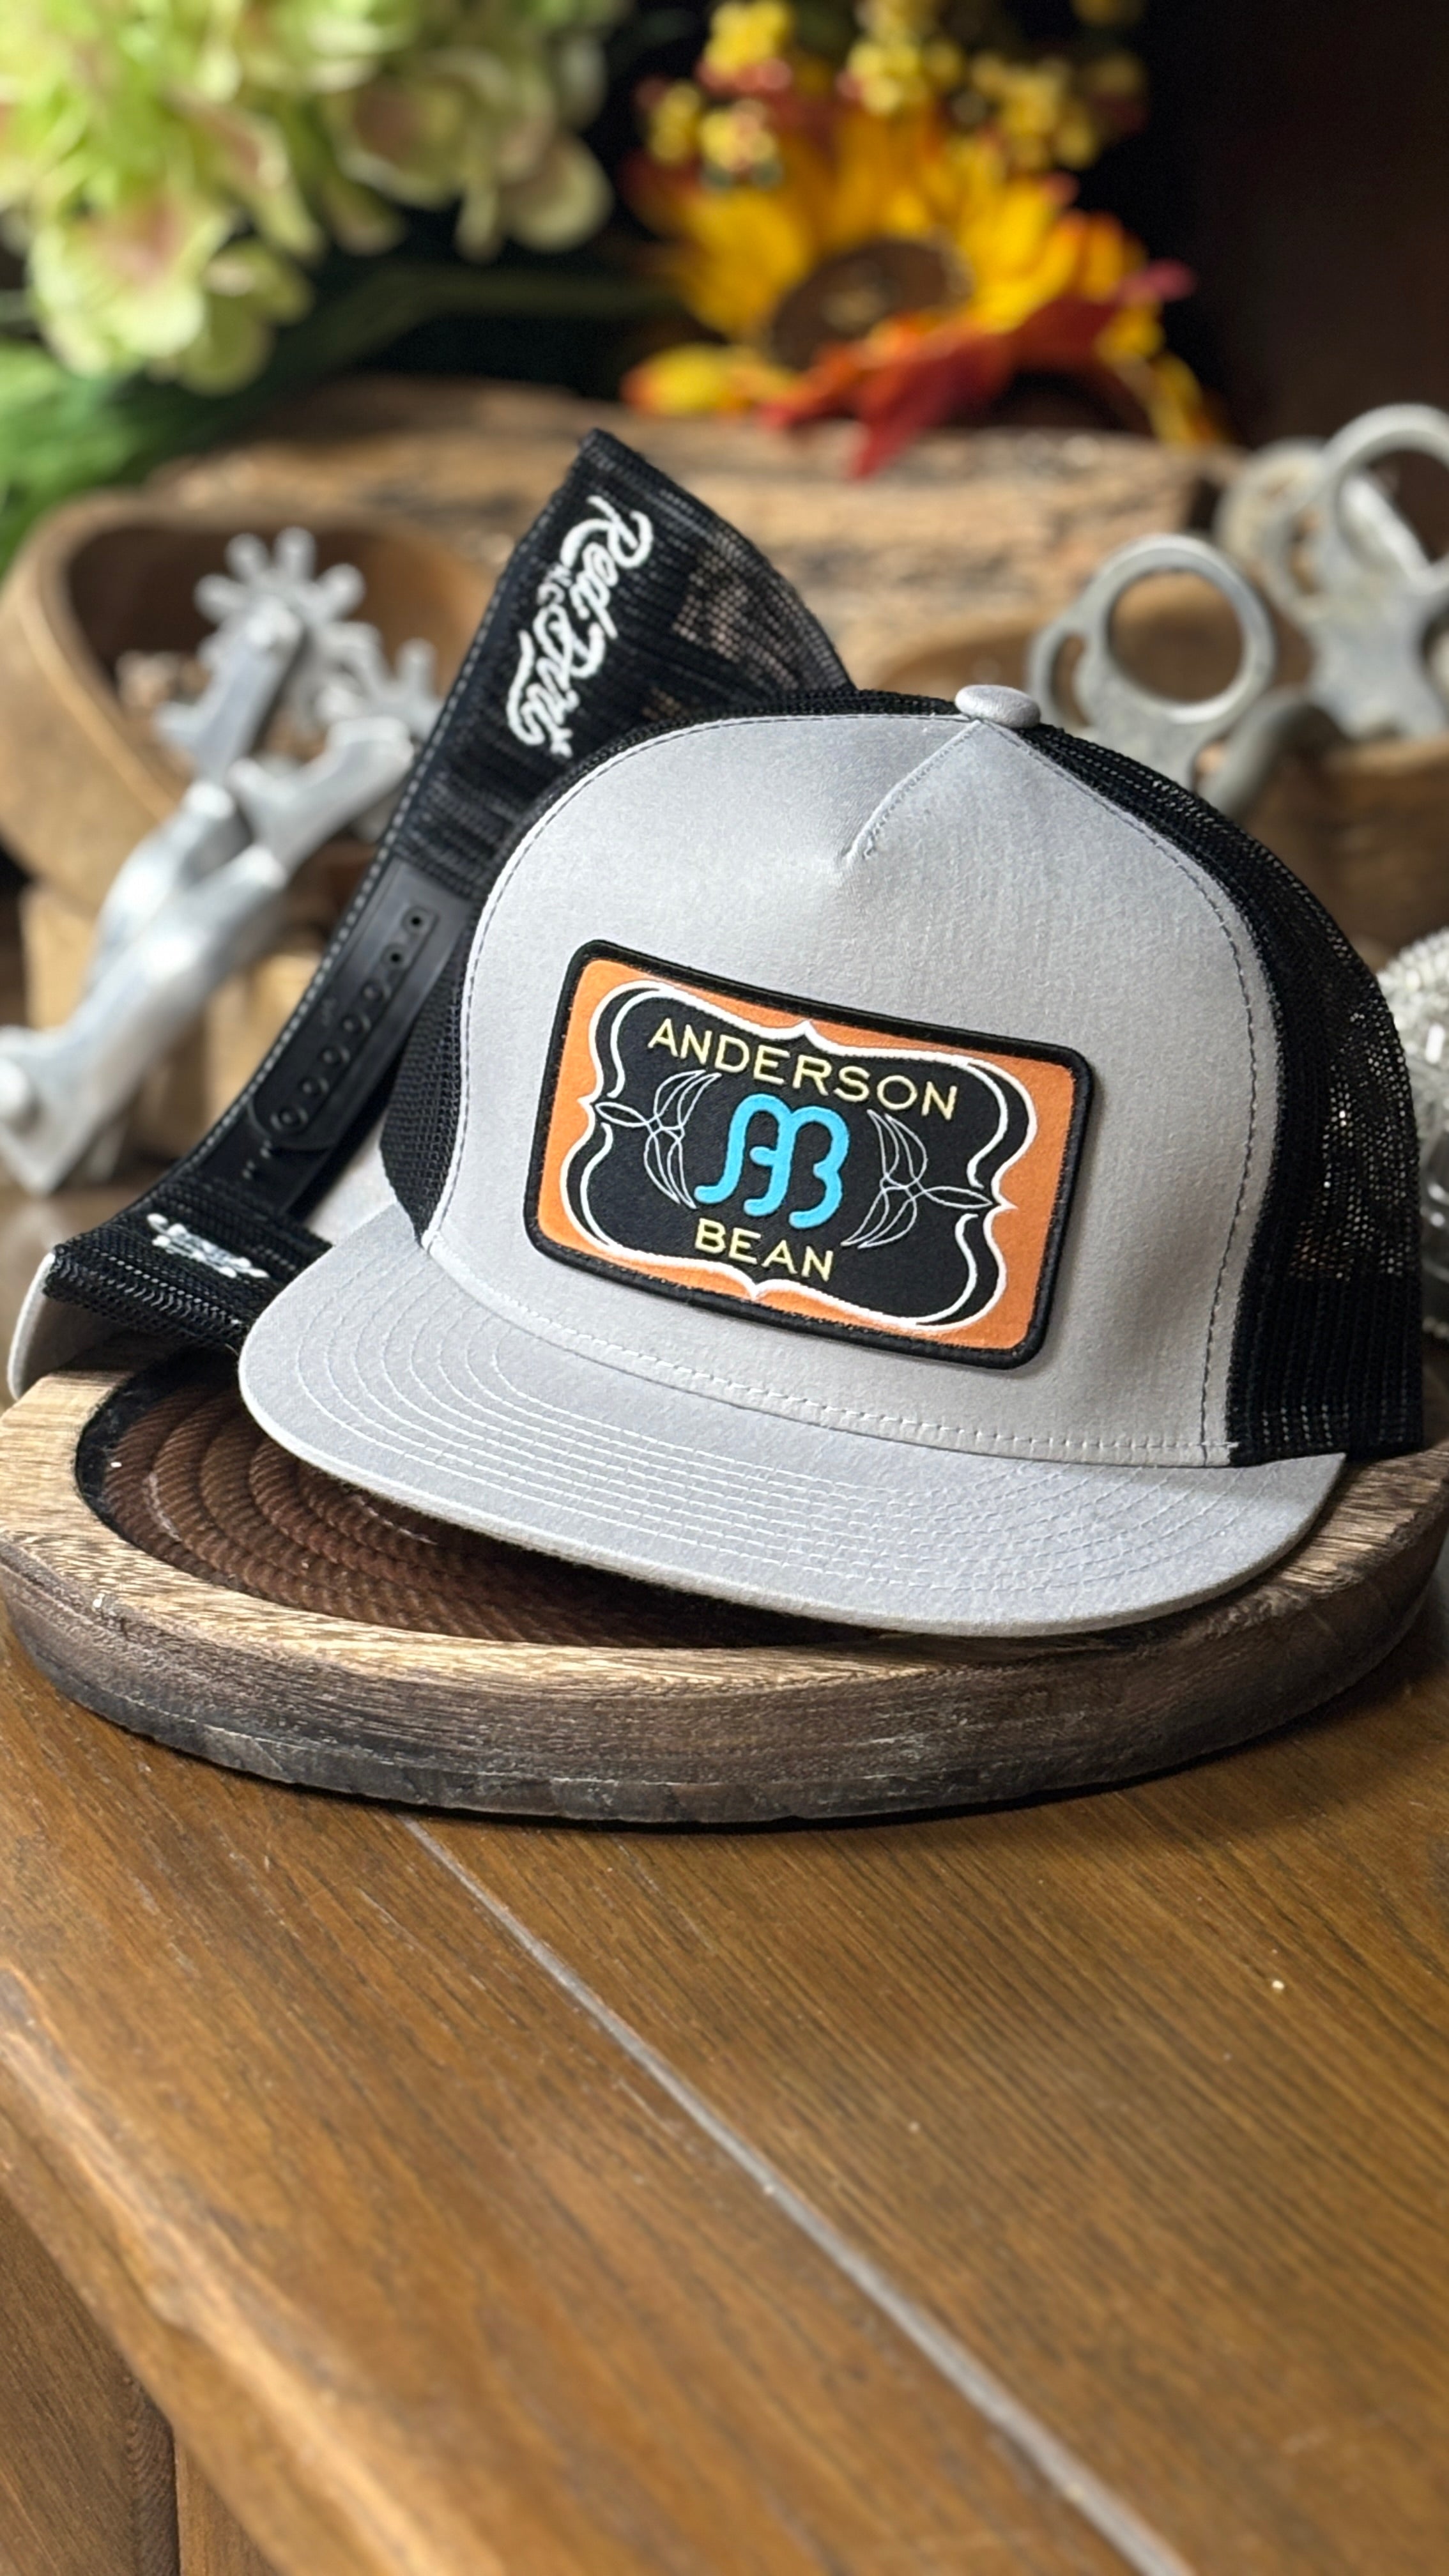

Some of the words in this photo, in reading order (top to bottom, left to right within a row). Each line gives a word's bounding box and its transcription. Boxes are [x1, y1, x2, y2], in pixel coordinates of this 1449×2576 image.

[560, 495, 654, 639] Red
[507, 608, 606, 756] Dirt
[647, 1018, 958, 1121] ANDERSON
[694, 1218, 834, 1281] BEAN
